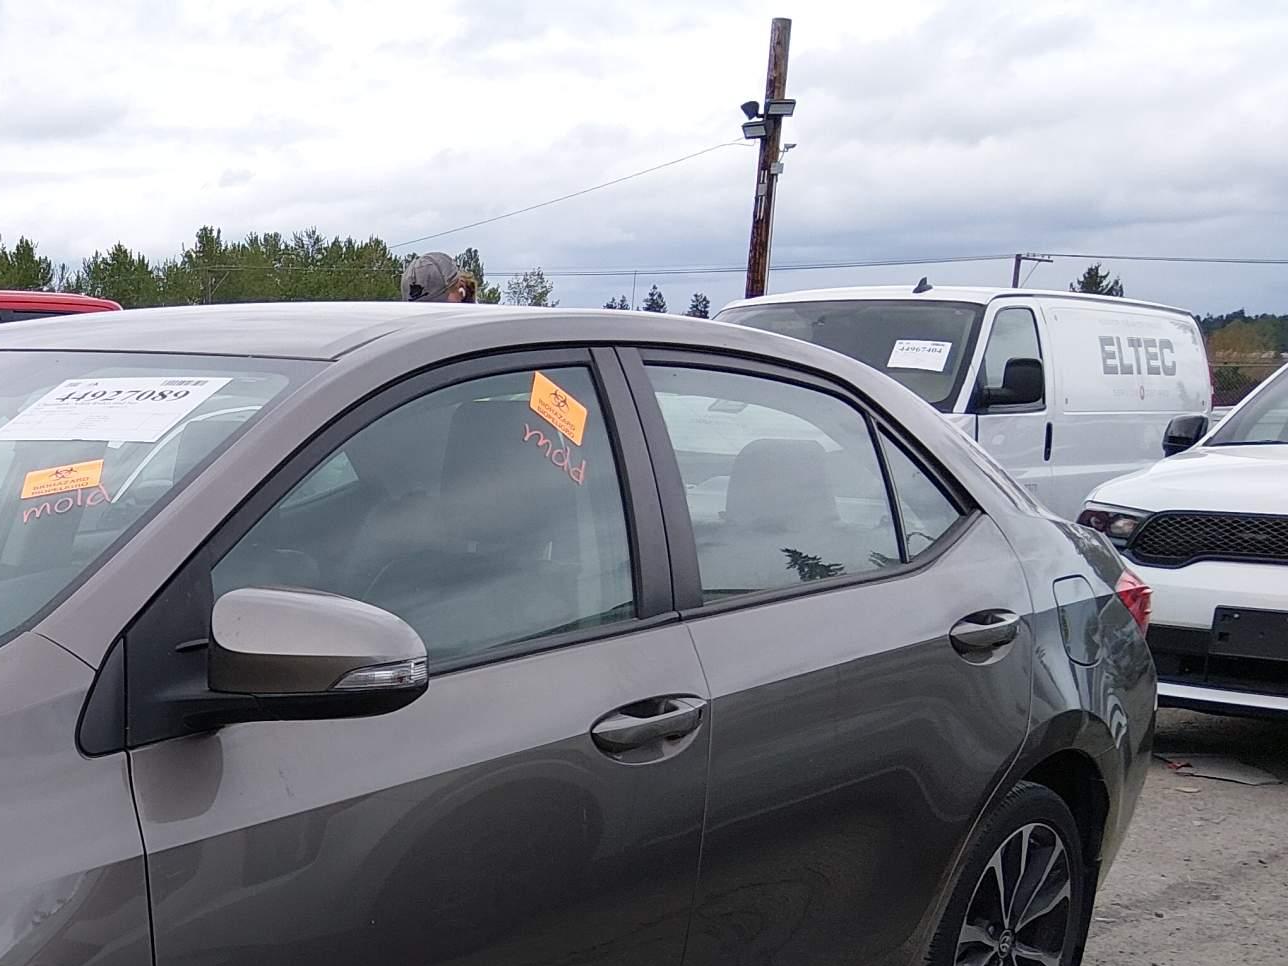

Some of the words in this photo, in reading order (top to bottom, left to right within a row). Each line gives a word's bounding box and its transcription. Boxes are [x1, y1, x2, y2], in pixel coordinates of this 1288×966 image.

[1098, 336, 1176, 376] ELTEC
[55, 390, 192, 402] 44927089
[23, 483, 111, 524] mold
